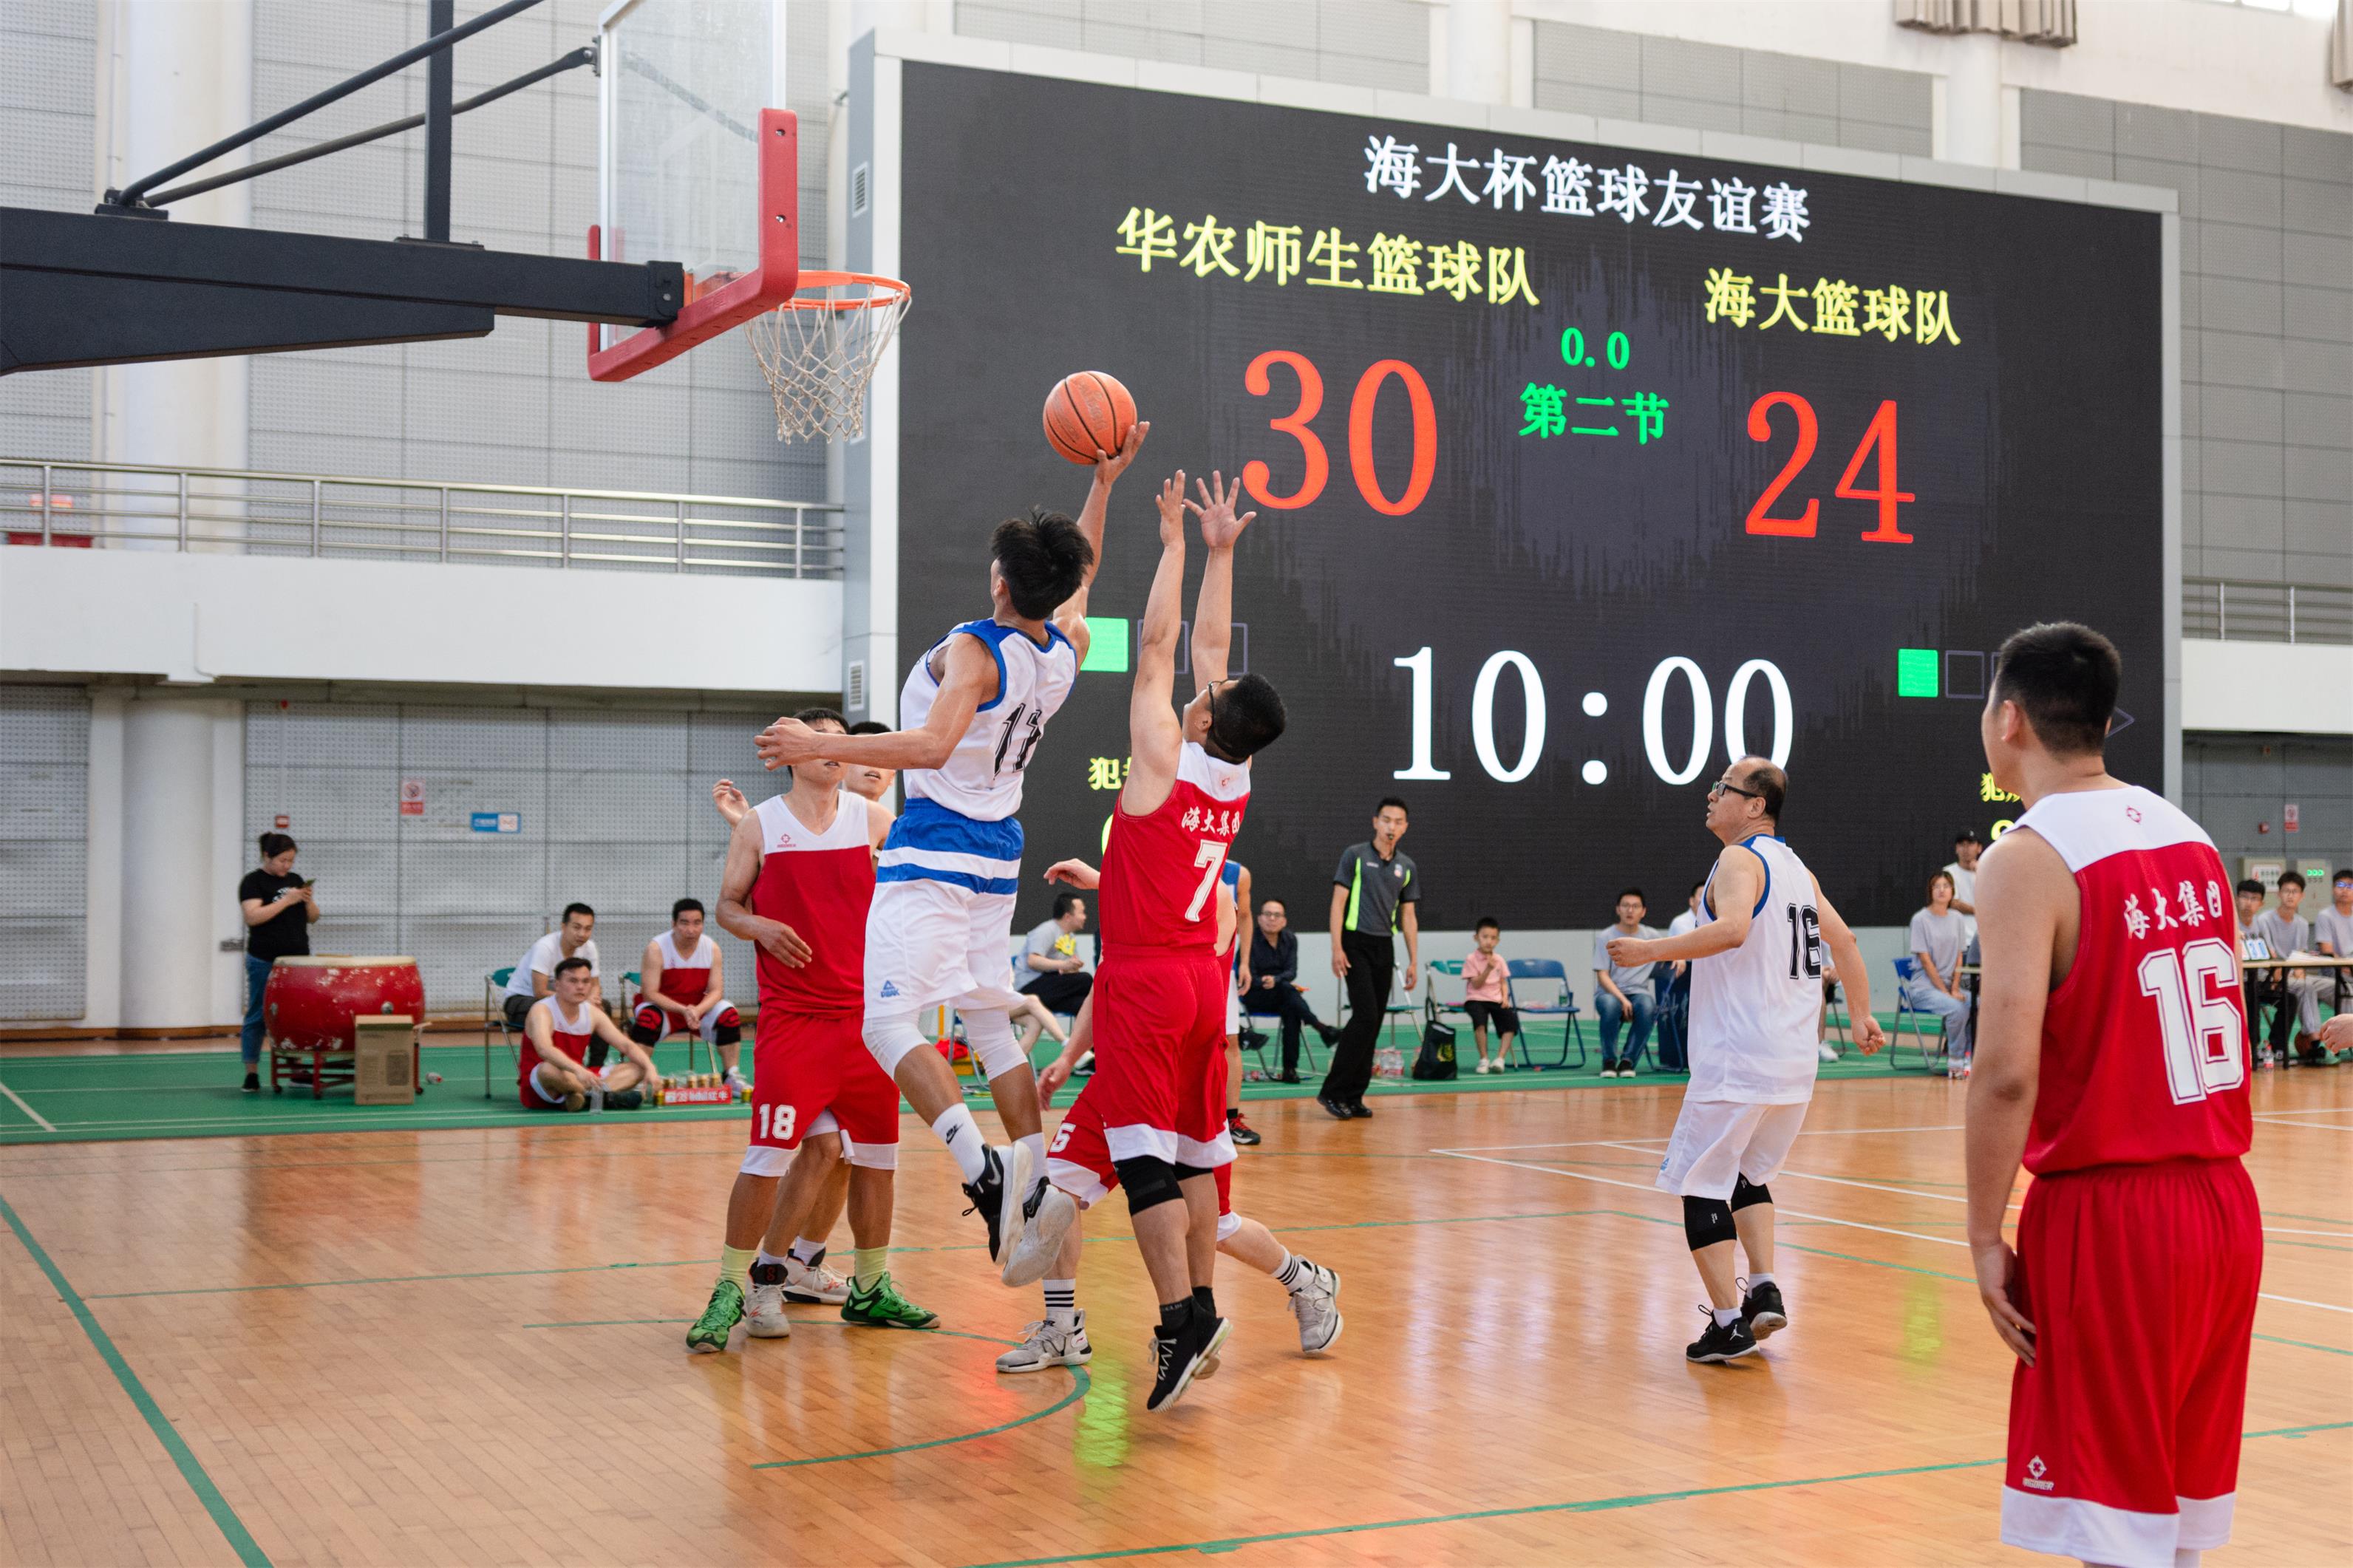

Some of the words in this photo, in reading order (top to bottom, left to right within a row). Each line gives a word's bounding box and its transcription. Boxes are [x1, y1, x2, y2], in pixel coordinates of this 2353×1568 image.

[1363, 134, 1811, 242] 海大杯篮球友谊赛
[1116, 206, 1540, 306] 华农师生篮球队
[1560, 327, 1630, 370] 0.0
[1704, 268, 1961, 346] 海大篮球队
[1242, 350, 1437, 517] 30
[1518, 382, 1669, 445] 第二节
[1745, 391, 1916, 544] 24
[1393, 646, 1794, 785] 10:00
[1182, 806, 1240, 837] 海大集团
[1185, 839, 1227, 922] 7
[1787, 903, 1821, 979] 16
[2137, 937, 2244, 1105] 16
[759, 1104, 797, 1140] 18
